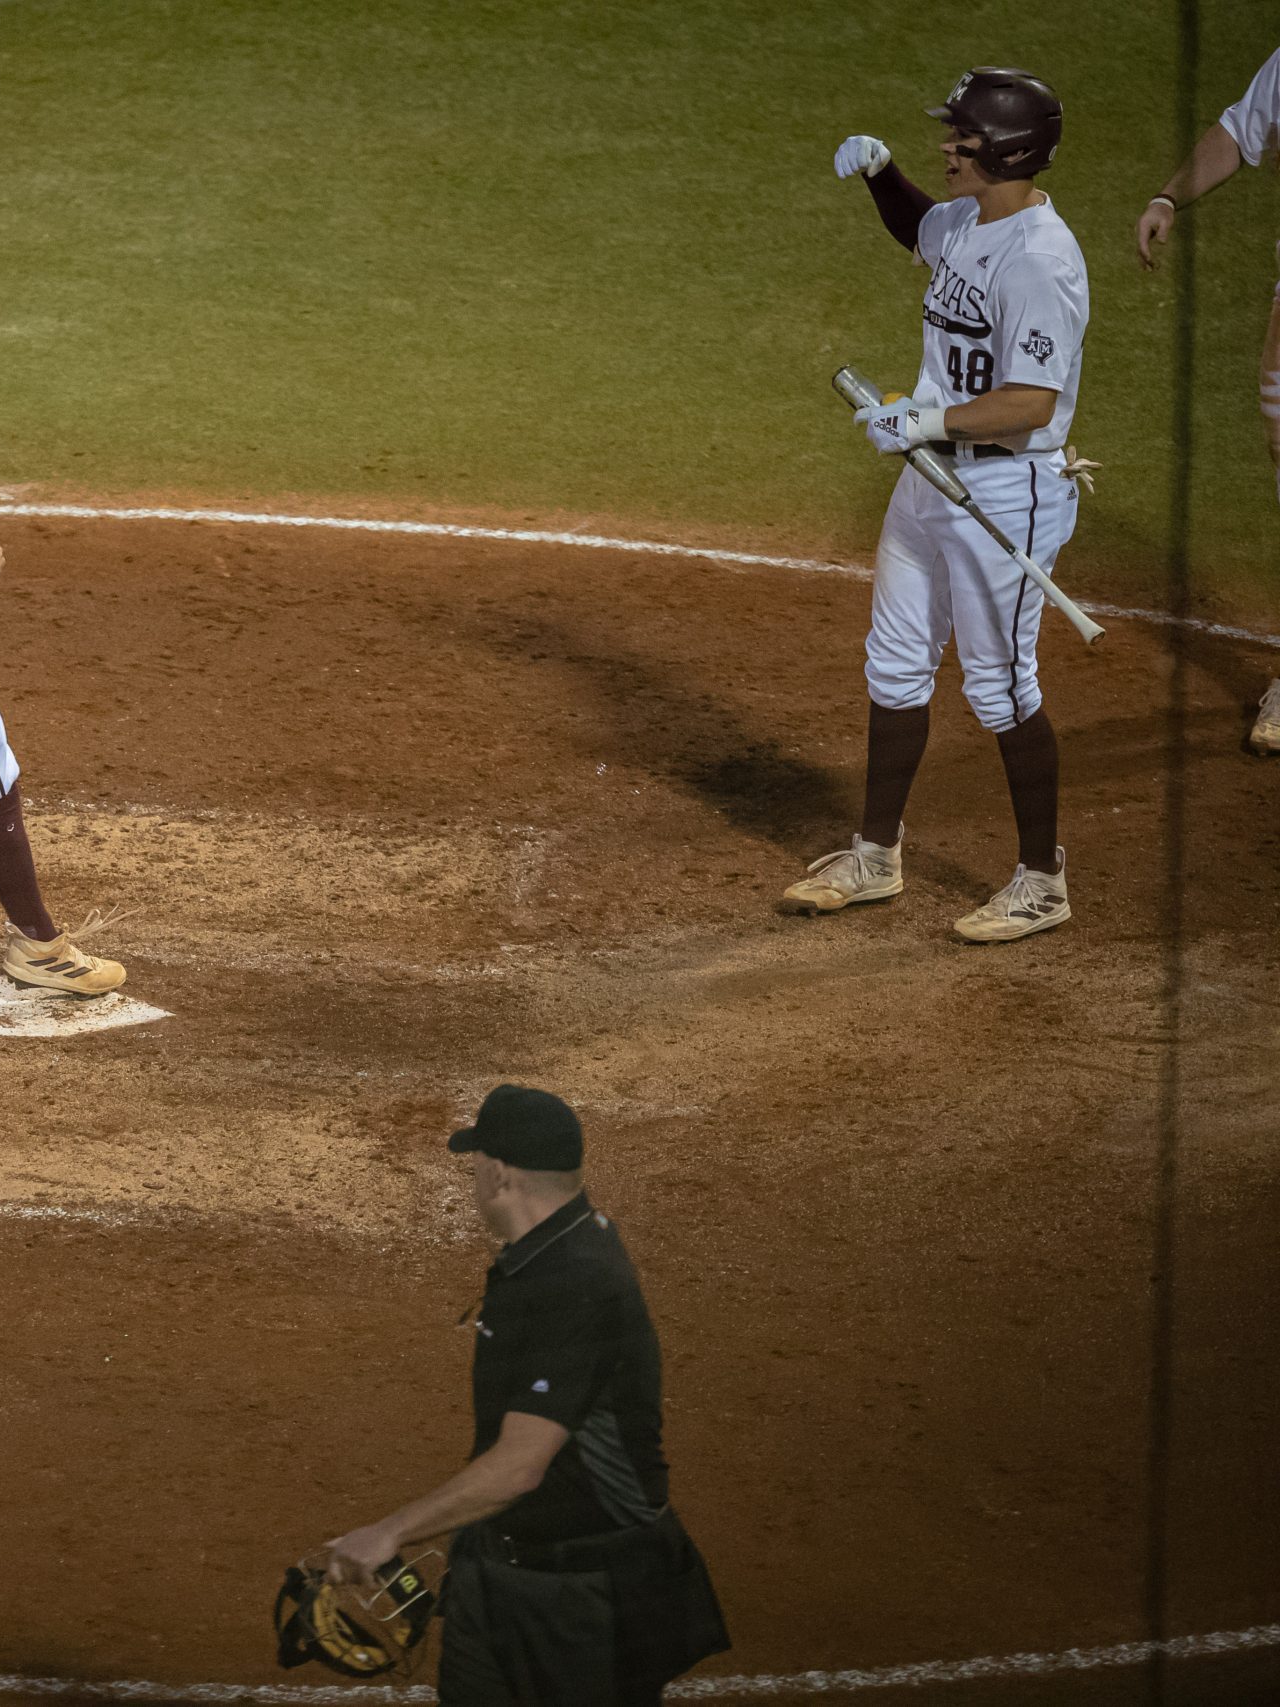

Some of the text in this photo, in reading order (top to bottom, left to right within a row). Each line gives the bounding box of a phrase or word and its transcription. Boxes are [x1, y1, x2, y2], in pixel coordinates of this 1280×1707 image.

[930, 256, 986, 323] EXAS
[947, 345, 995, 396] 48
[873, 420, 900, 438] adidas
